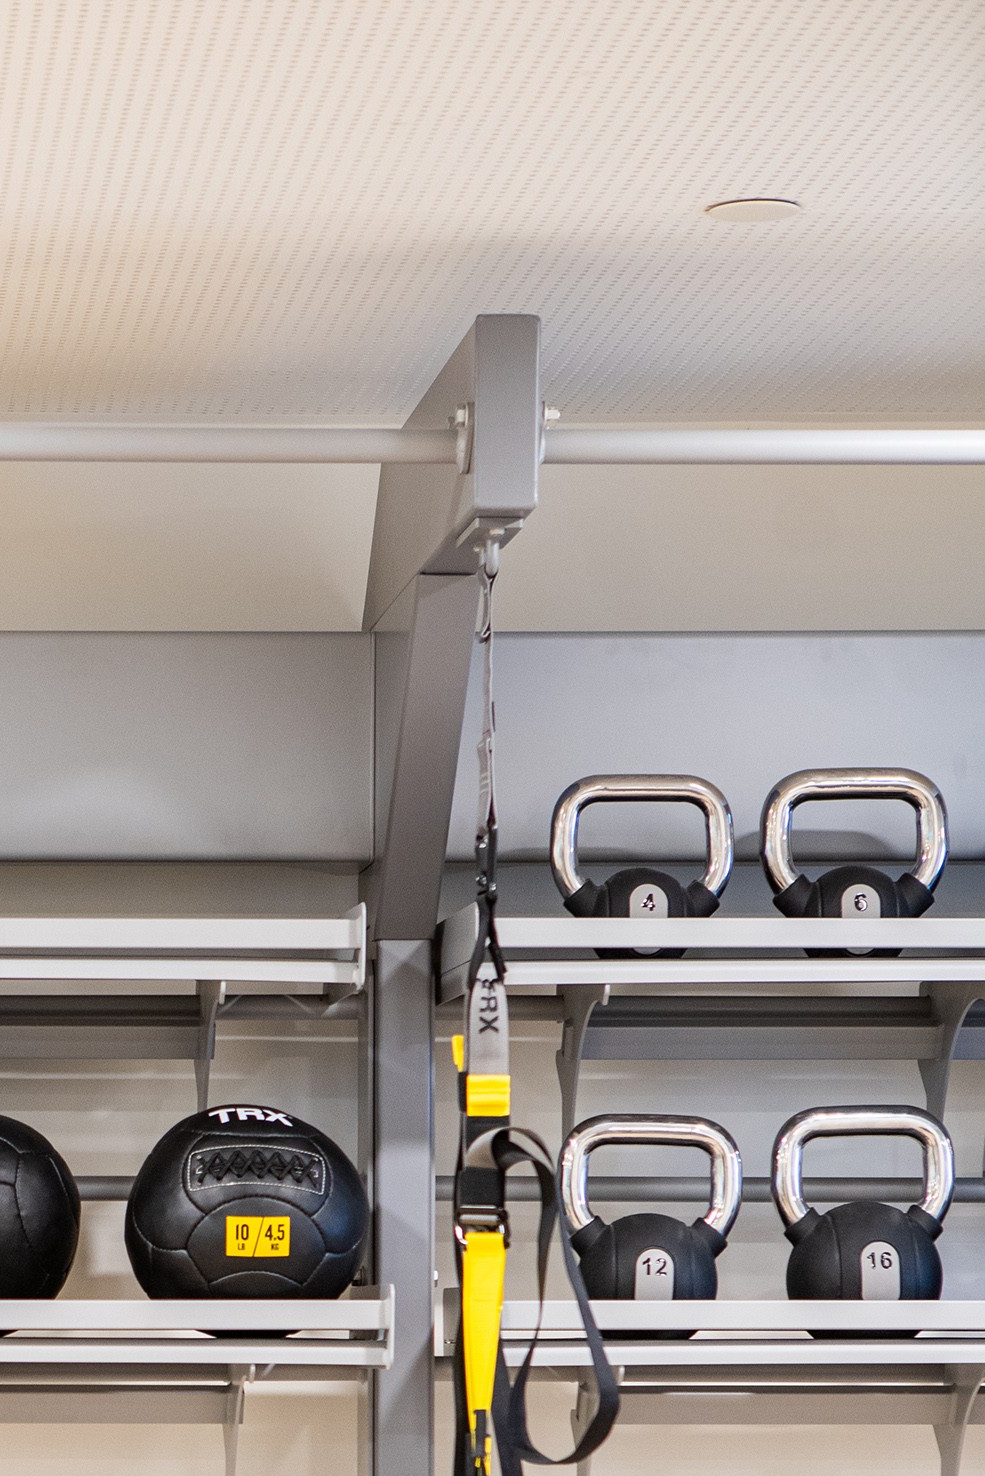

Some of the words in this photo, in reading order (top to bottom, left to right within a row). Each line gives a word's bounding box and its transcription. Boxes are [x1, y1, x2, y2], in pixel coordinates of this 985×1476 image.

[640, 893, 656, 912] 4
[854, 892, 868, 912] 6
[208, 1107, 294, 1128] TRX
[235, 1223, 250, 1241] 10
[264, 1223, 286, 1241] 4.5
[237, 1243, 247, 1251] LB
[270, 1243, 280, 1251] KG
[642, 1257, 668, 1277] 12
[866, 1251, 893, 1270] 16
